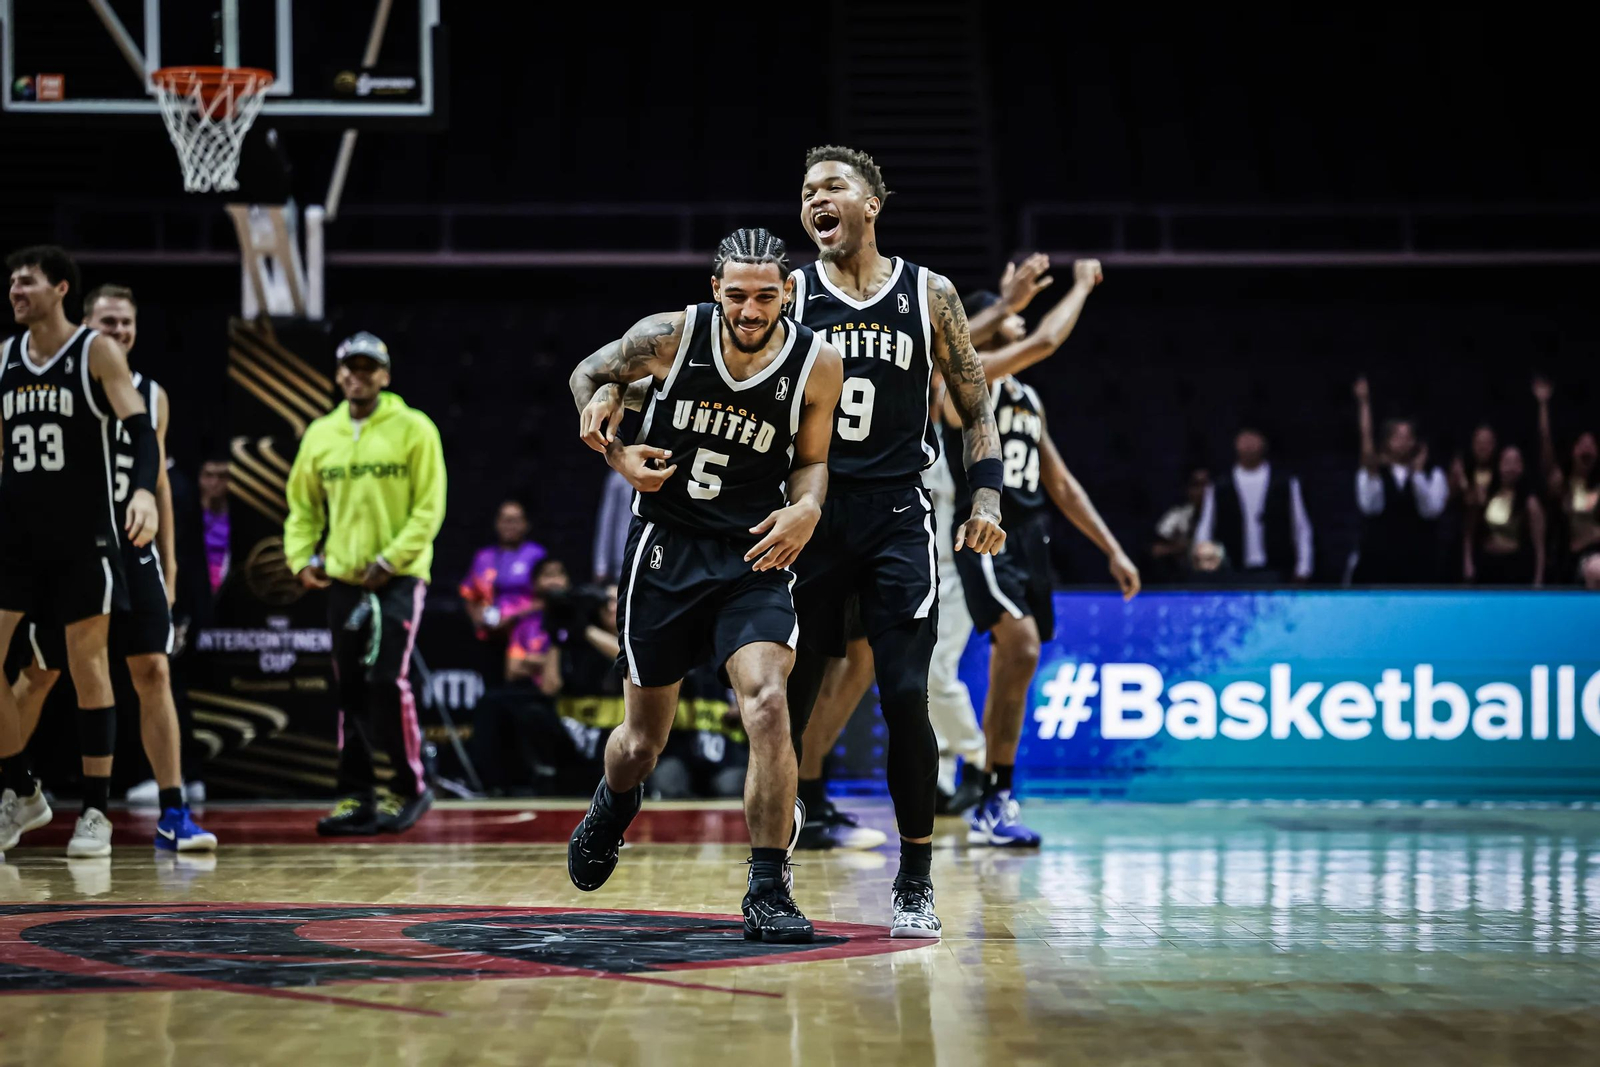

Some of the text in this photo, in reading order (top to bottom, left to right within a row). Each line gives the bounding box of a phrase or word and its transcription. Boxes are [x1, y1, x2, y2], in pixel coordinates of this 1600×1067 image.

[815, 328, 914, 371] NITED
[832, 322, 892, 333] NBAGL
[2, 386, 74, 421] UNITED
[672, 399, 776, 454] UNITED
[699, 400, 758, 422] NBAGL
[837, 376, 876, 442] 9
[11, 423, 65, 473] 33
[1003, 438, 1040, 493] 24
[687, 447, 730, 500] 5
